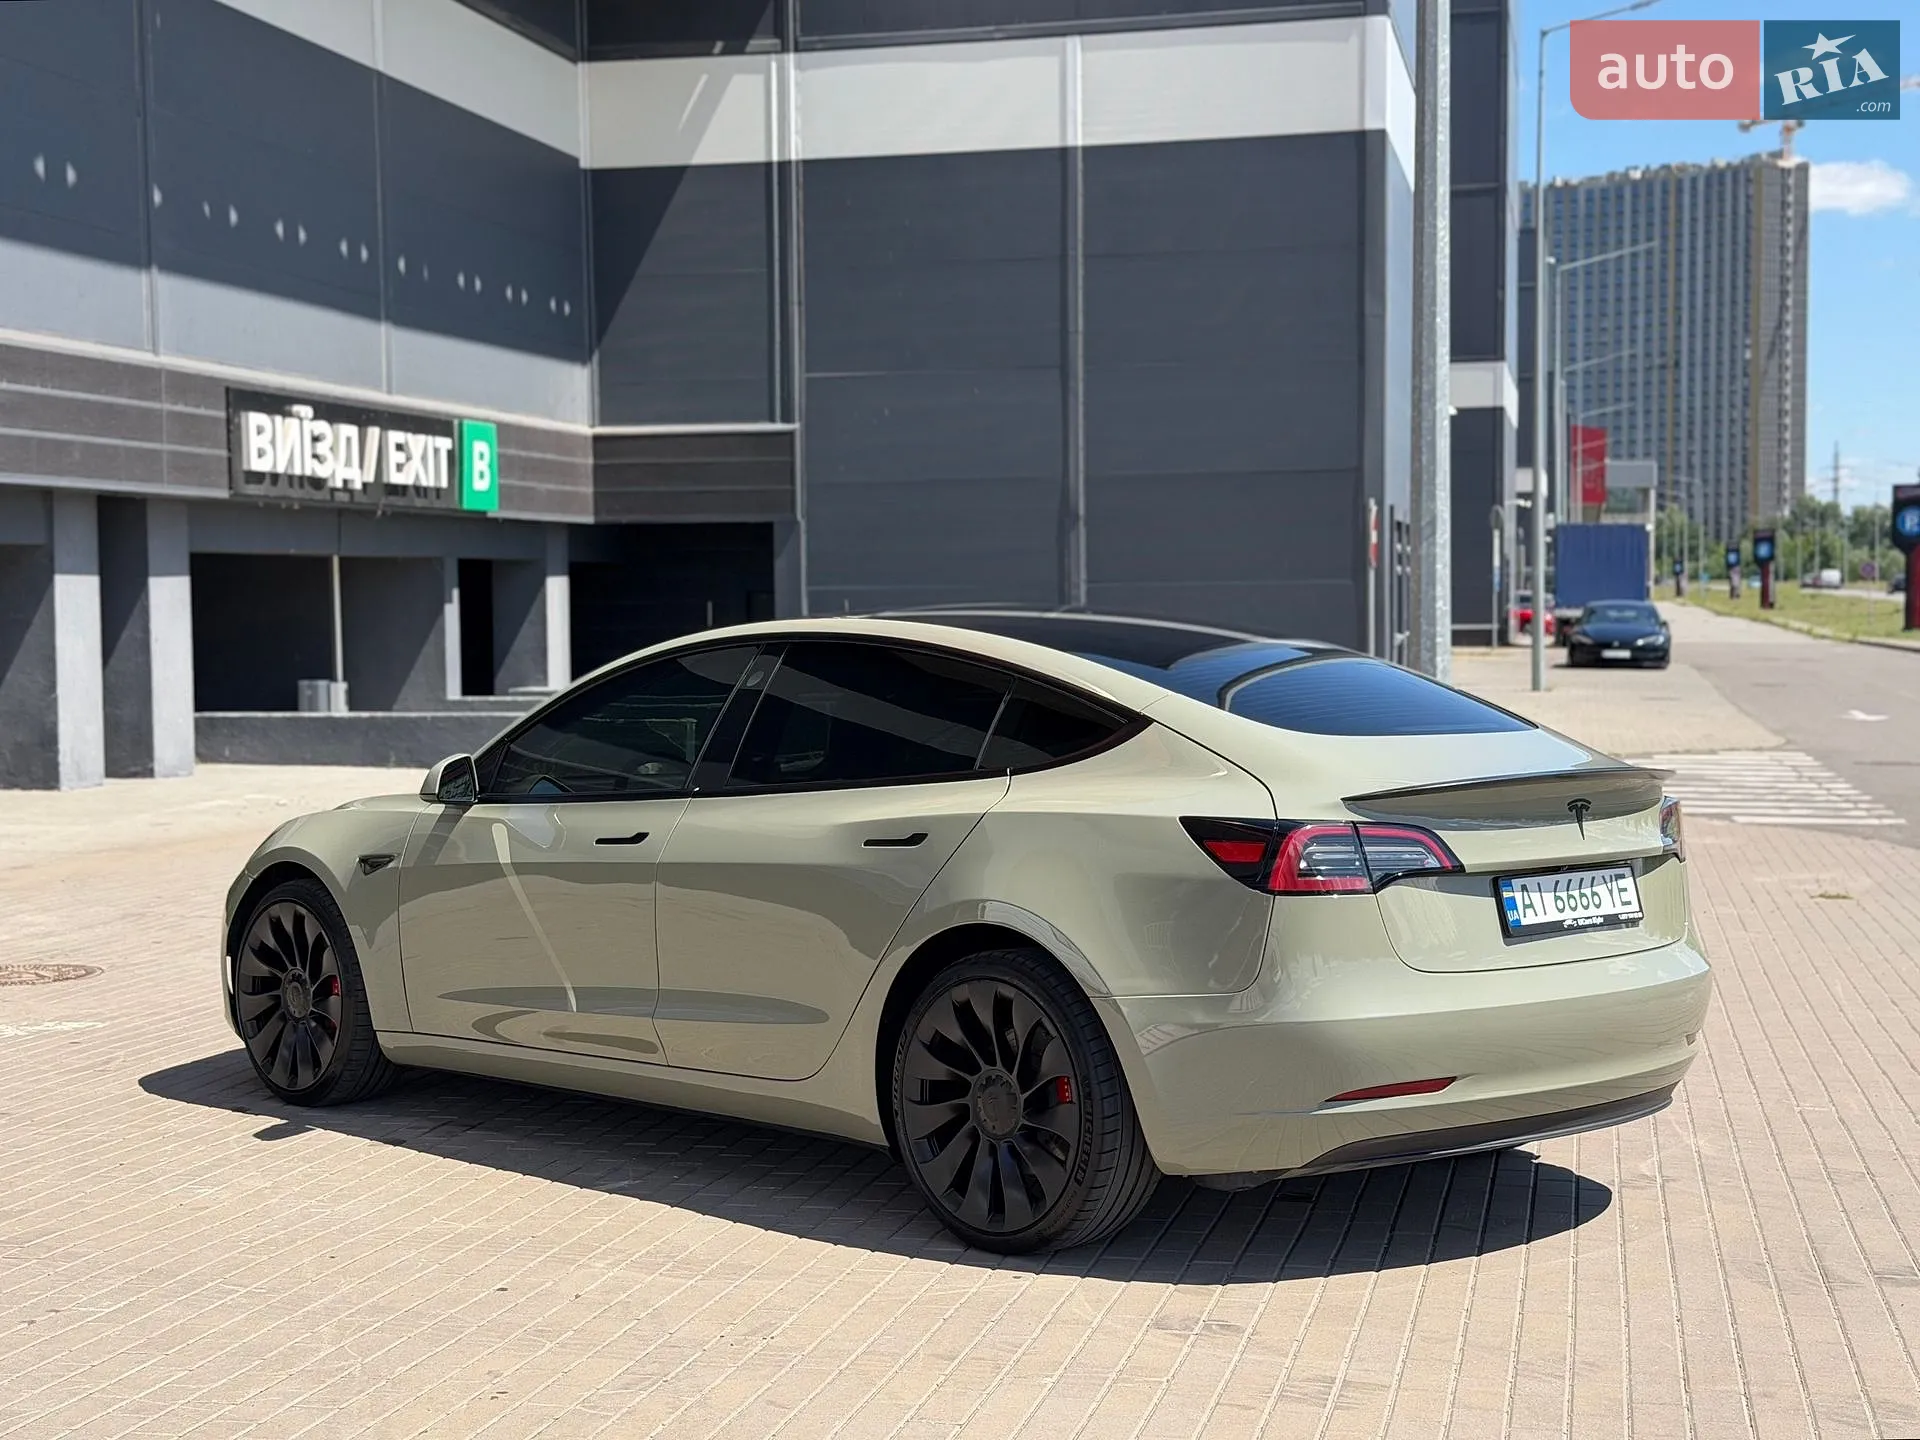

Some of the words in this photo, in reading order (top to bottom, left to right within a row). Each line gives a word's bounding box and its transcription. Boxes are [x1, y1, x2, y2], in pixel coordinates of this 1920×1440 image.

[471, 440, 491, 492] B
[1553, 876, 1602, 914] 6666
[1601, 873, 1632, 908] YE
[1507, 910, 1520, 921] UA
